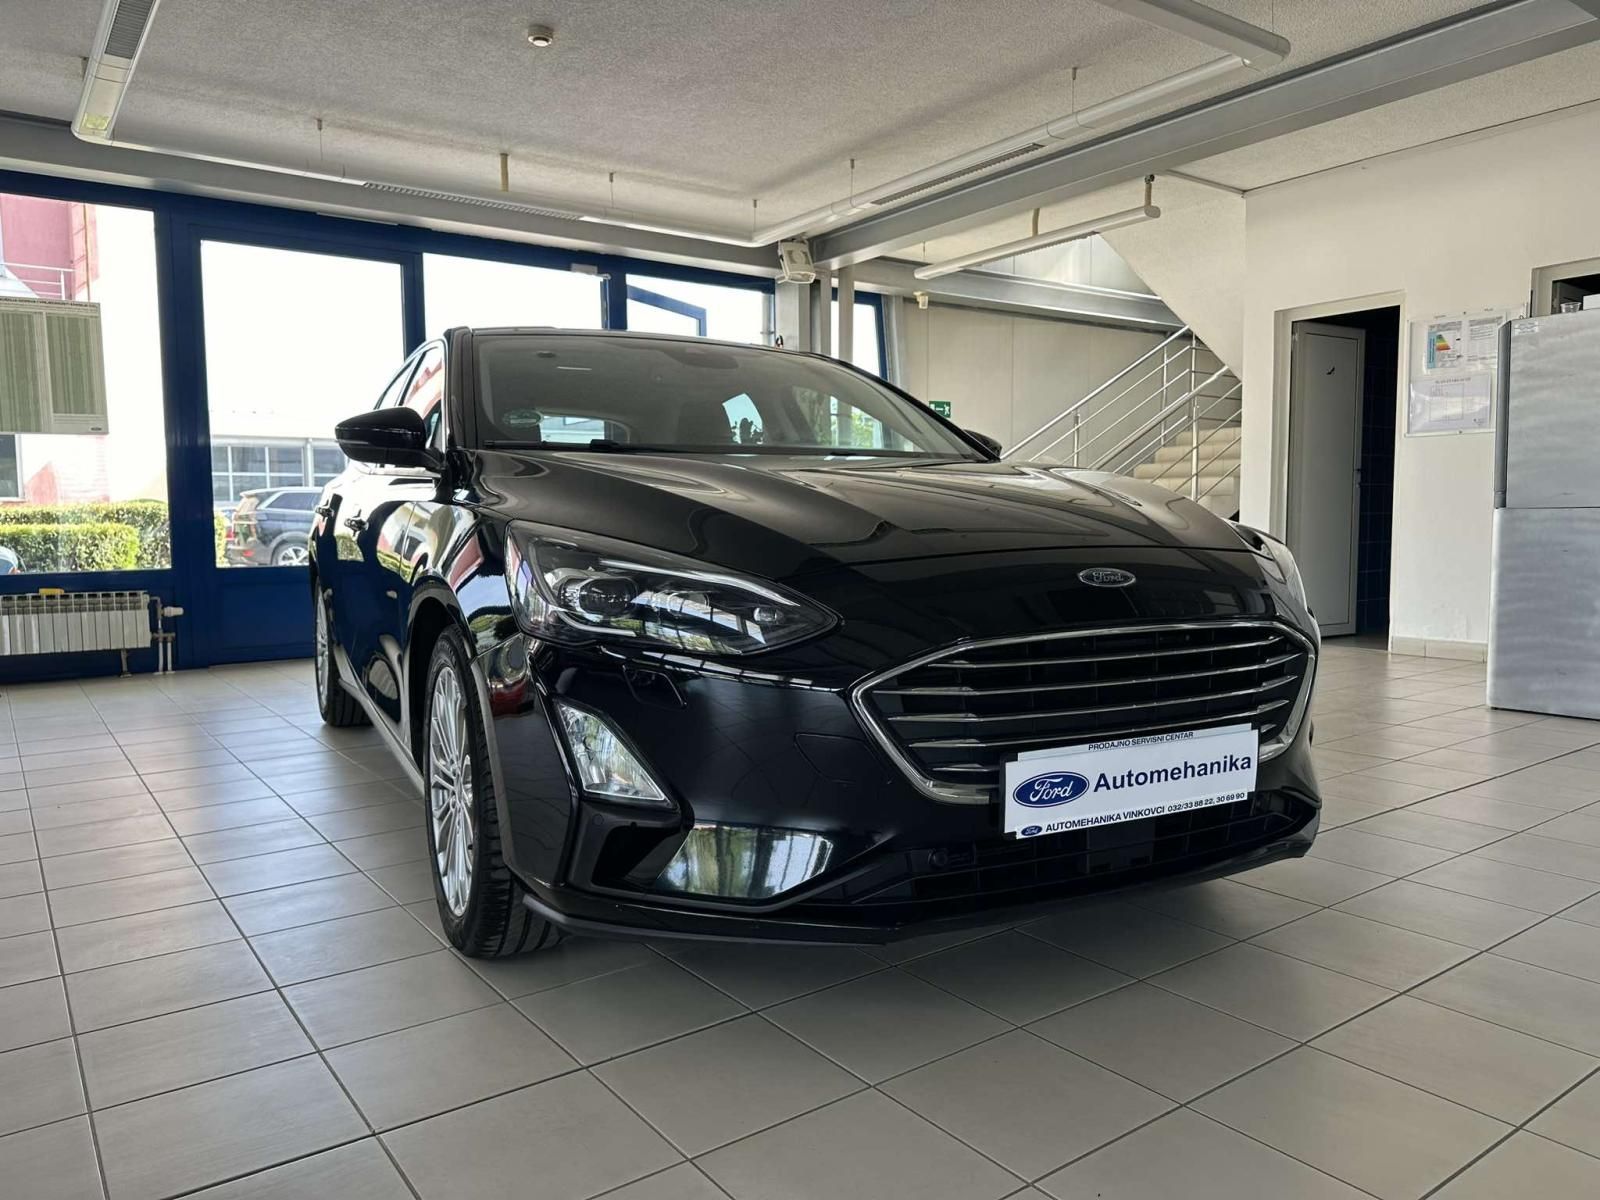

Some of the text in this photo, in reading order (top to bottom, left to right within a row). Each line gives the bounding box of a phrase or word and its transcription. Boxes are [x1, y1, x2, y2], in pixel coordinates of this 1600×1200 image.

[1092, 571, 1124, 583] Ford
[1088, 731, 1194, 750] PRODAJNO SERVISNI CENTAR
[1093, 754, 1252, 793] Automehanika
[1029, 777, 1073, 802] Ford
[1045, 813, 1122, 832] AUTOMEHANIKA
[1122, 806, 1165, 819] VINKOVCI
[1167, 801, 1193, 812] 032/33
[1216, 795, 1225, 803] 30
